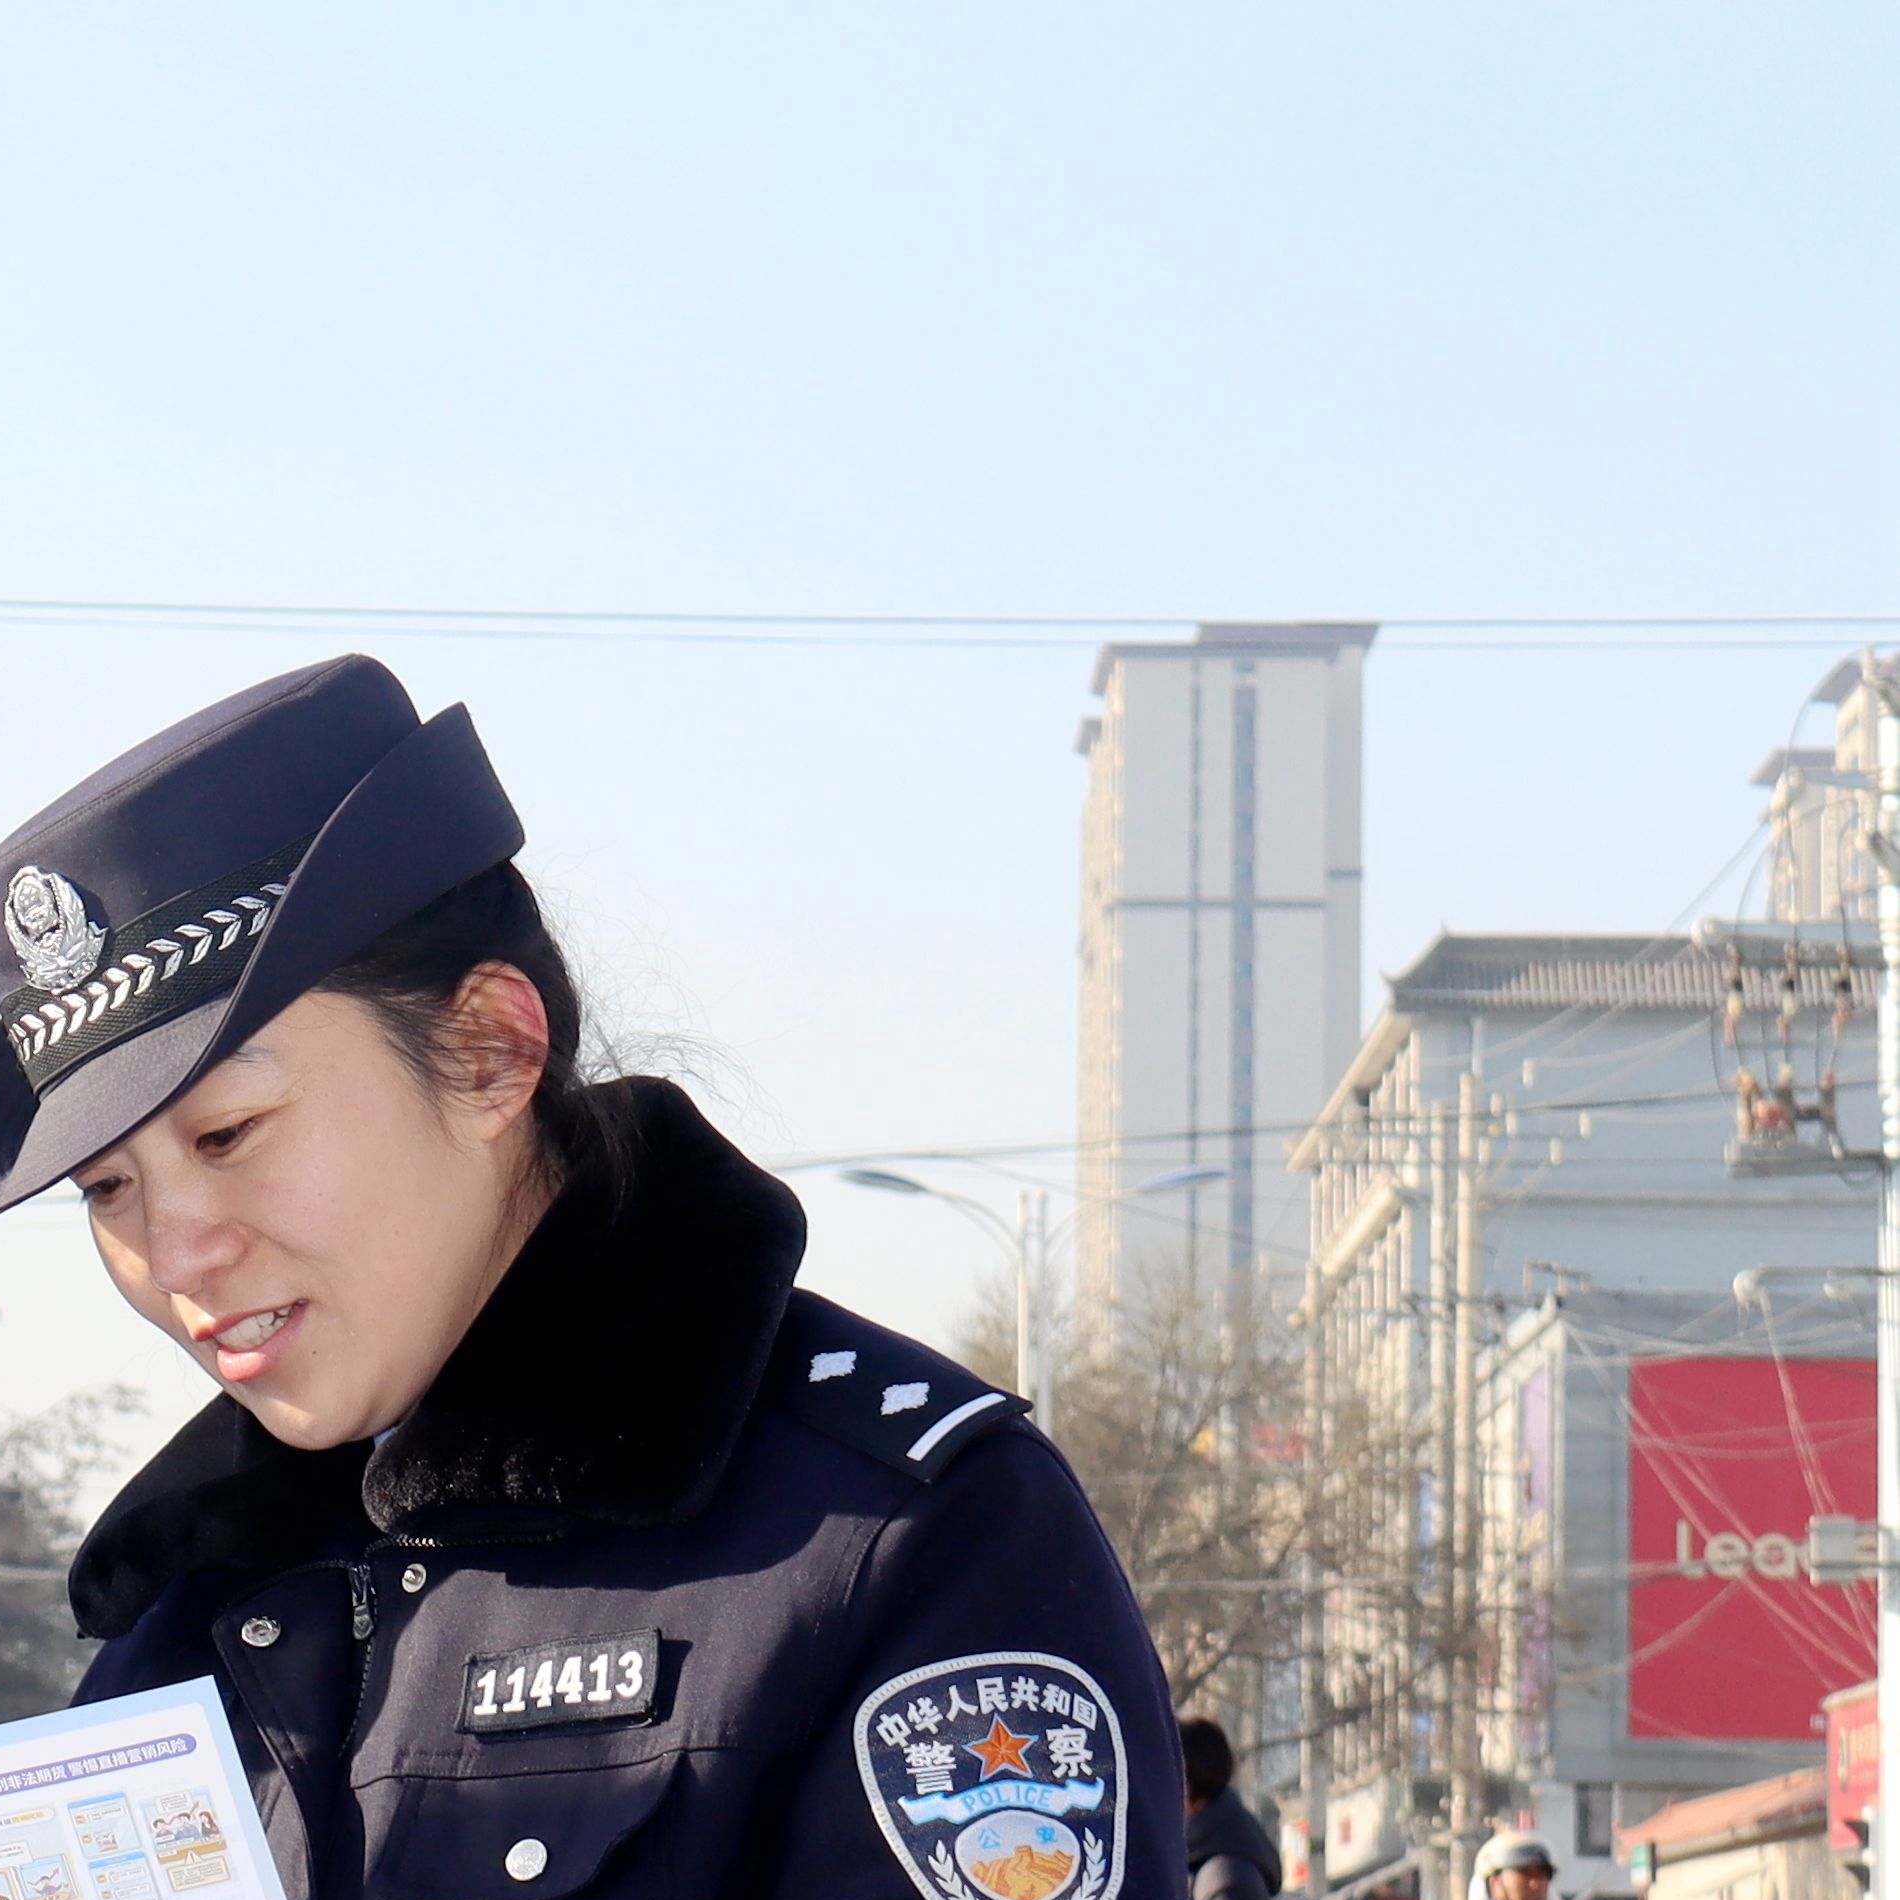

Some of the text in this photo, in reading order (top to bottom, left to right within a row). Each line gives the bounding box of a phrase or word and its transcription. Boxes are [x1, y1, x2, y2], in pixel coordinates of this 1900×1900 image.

[473, 1650, 644, 1715] 114413
[875, 1675, 1098, 1749] 中华人民共和国
[962, 1783, 1053, 1812] POLICE
